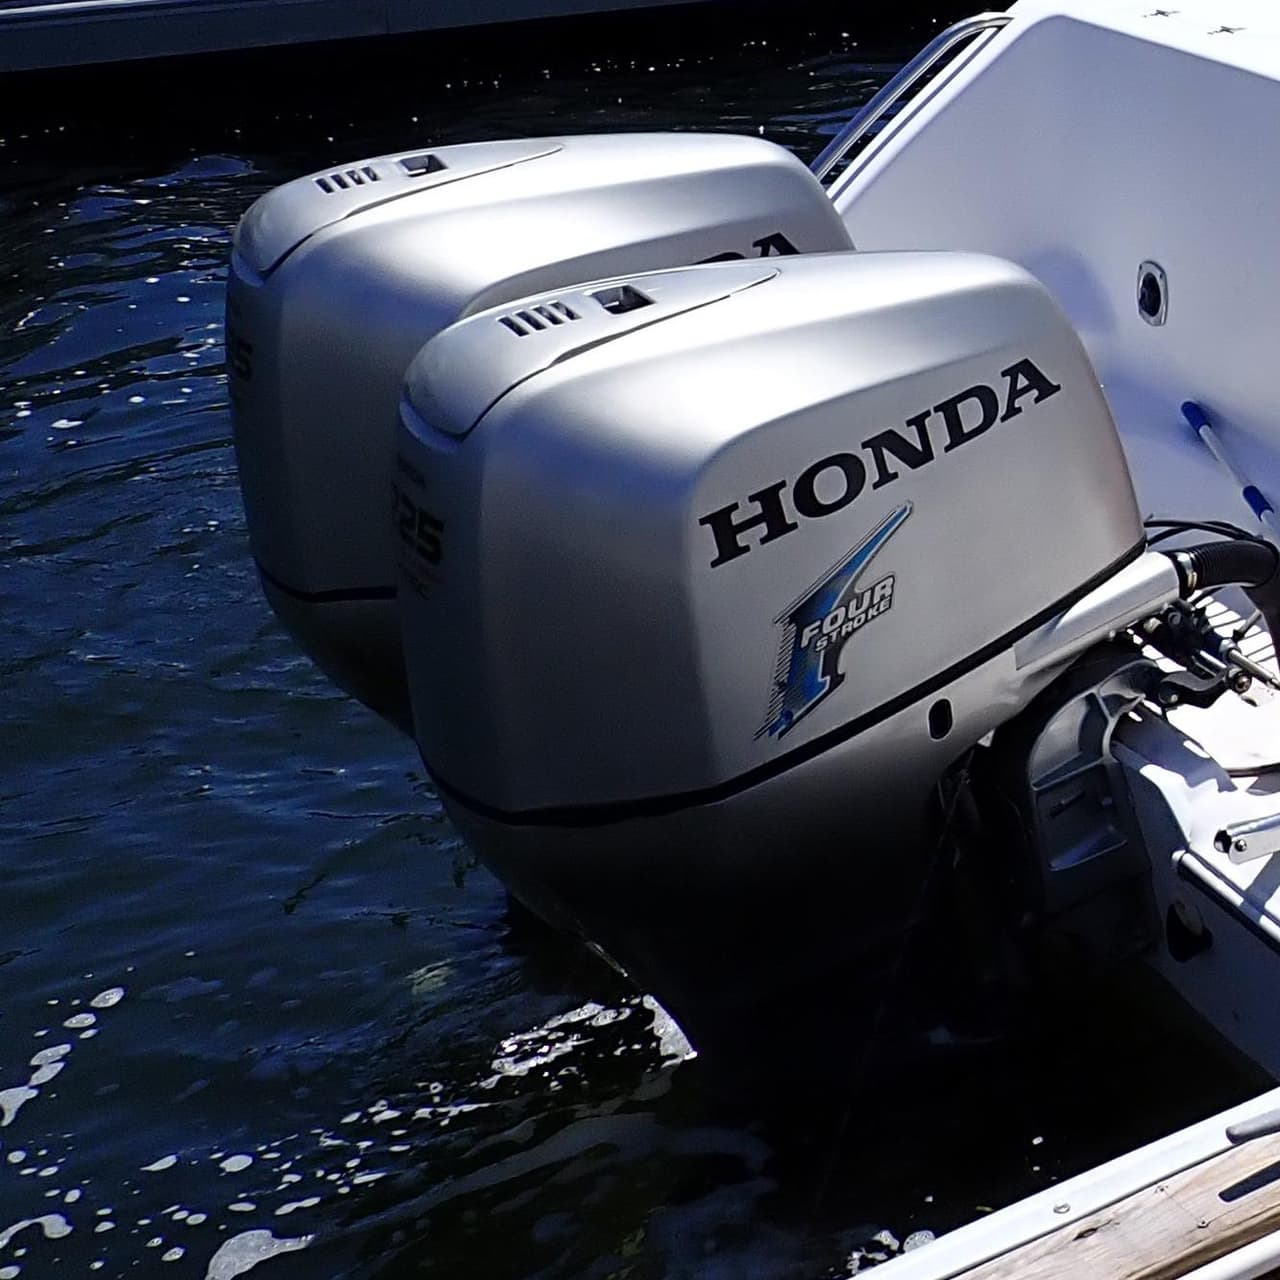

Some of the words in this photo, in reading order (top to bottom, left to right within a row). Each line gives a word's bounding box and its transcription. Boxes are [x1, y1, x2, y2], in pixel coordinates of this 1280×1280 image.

[698, 358, 1061, 570] HONDA
[800, 576, 895, 648] FOUR
[815, 597, 892, 652] STROKE
